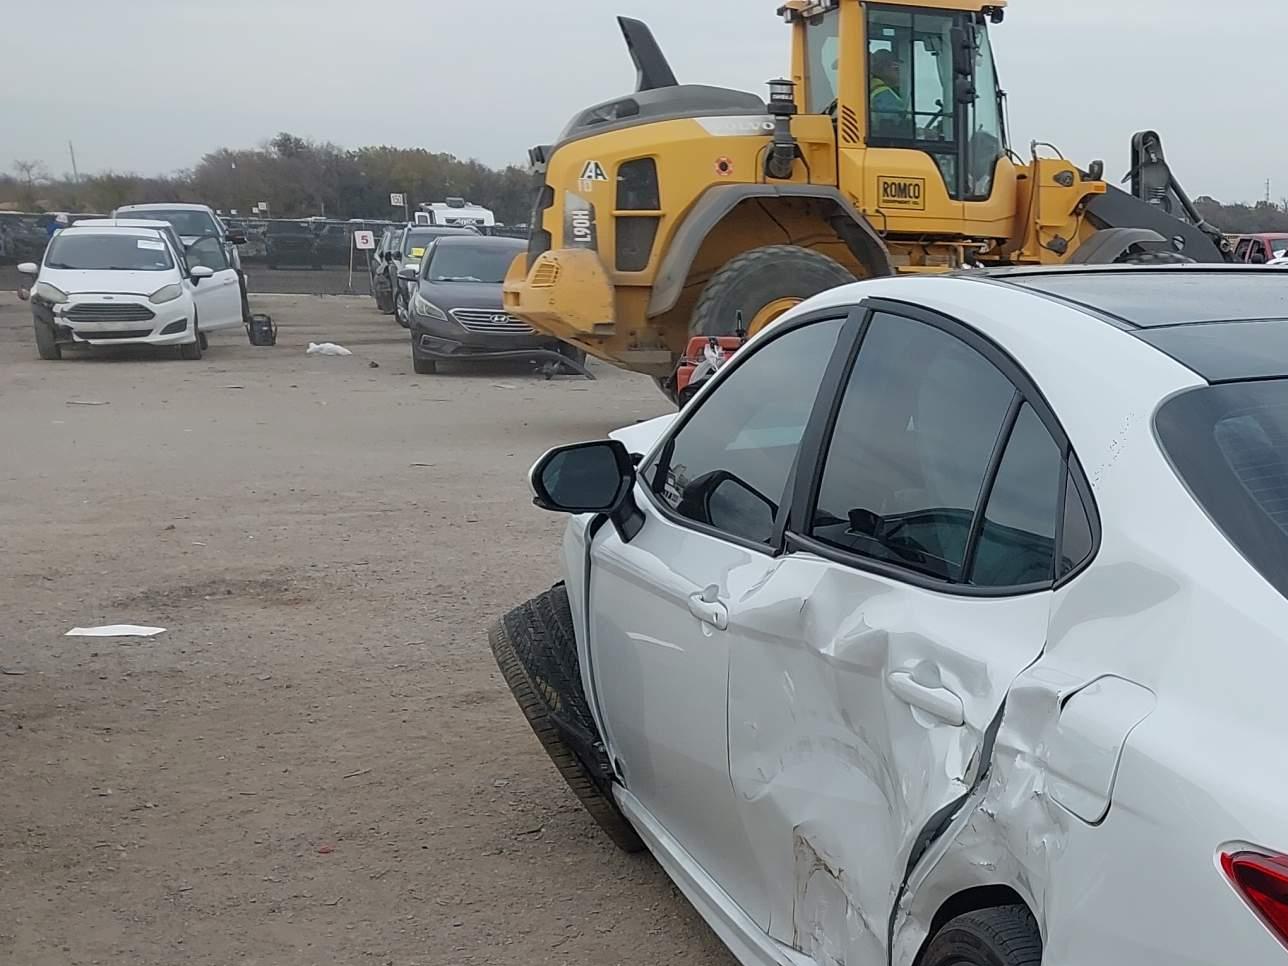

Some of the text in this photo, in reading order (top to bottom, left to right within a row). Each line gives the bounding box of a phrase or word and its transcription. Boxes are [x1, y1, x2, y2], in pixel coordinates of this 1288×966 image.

[882, 181, 921, 199] ROMCO
[572, 210, 592, 242] L90H
[360, 235, 369, 245] 5
